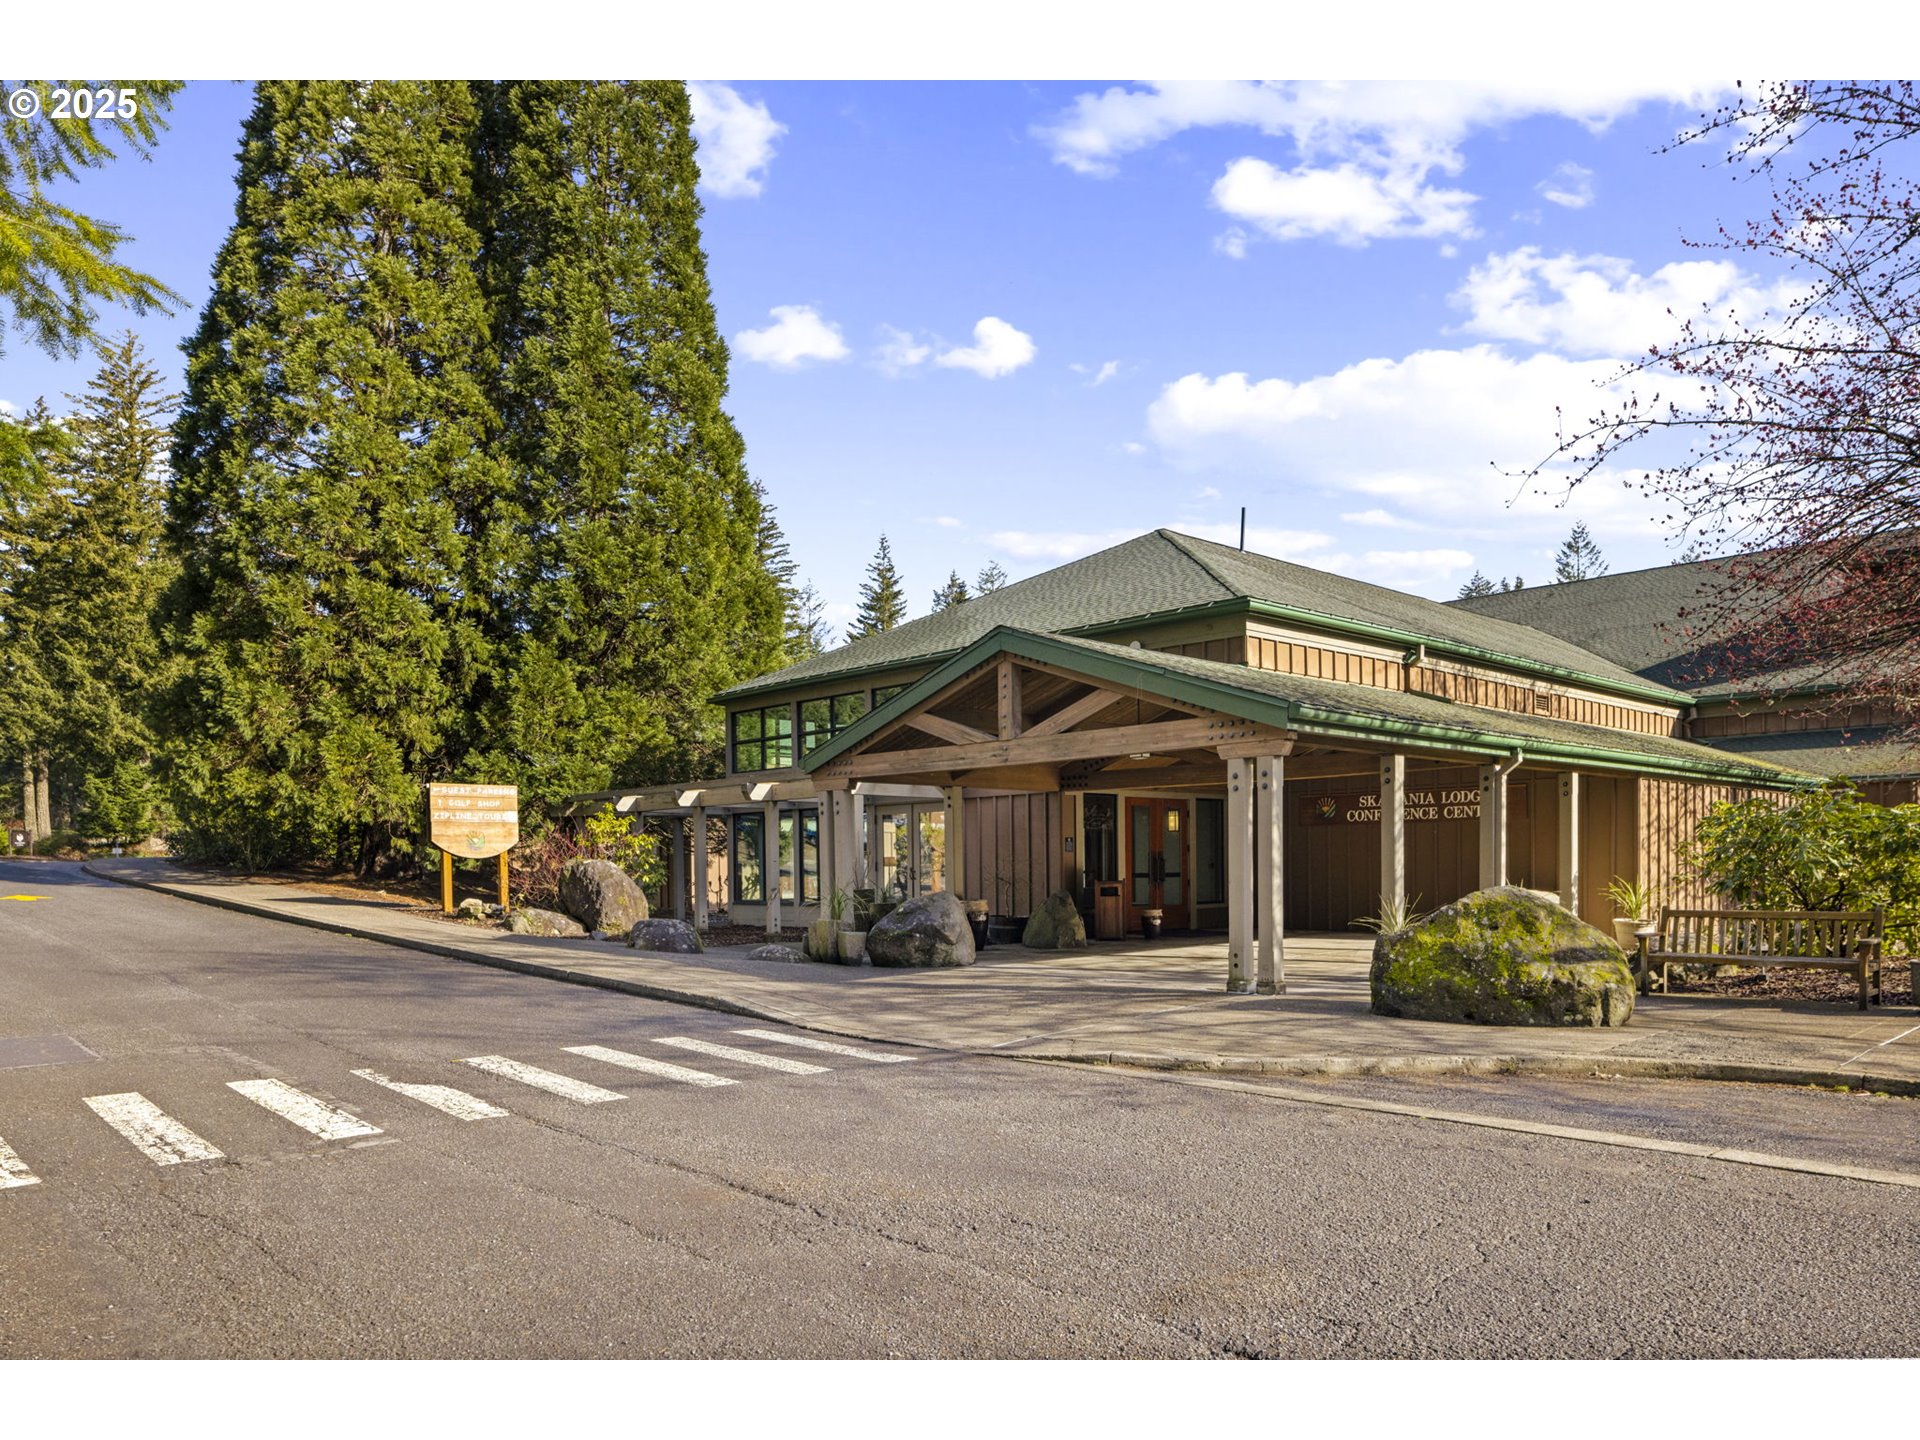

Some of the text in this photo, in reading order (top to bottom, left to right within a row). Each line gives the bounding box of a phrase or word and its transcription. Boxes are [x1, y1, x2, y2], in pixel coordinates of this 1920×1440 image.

[448, 799, 500, 808] GOLF SHOP
[1359, 790, 1480, 807] SKANIA LODG
[433, 811, 472, 820] ZIPLINE
[1346, 805, 1480, 822] CONFENCE CENT
